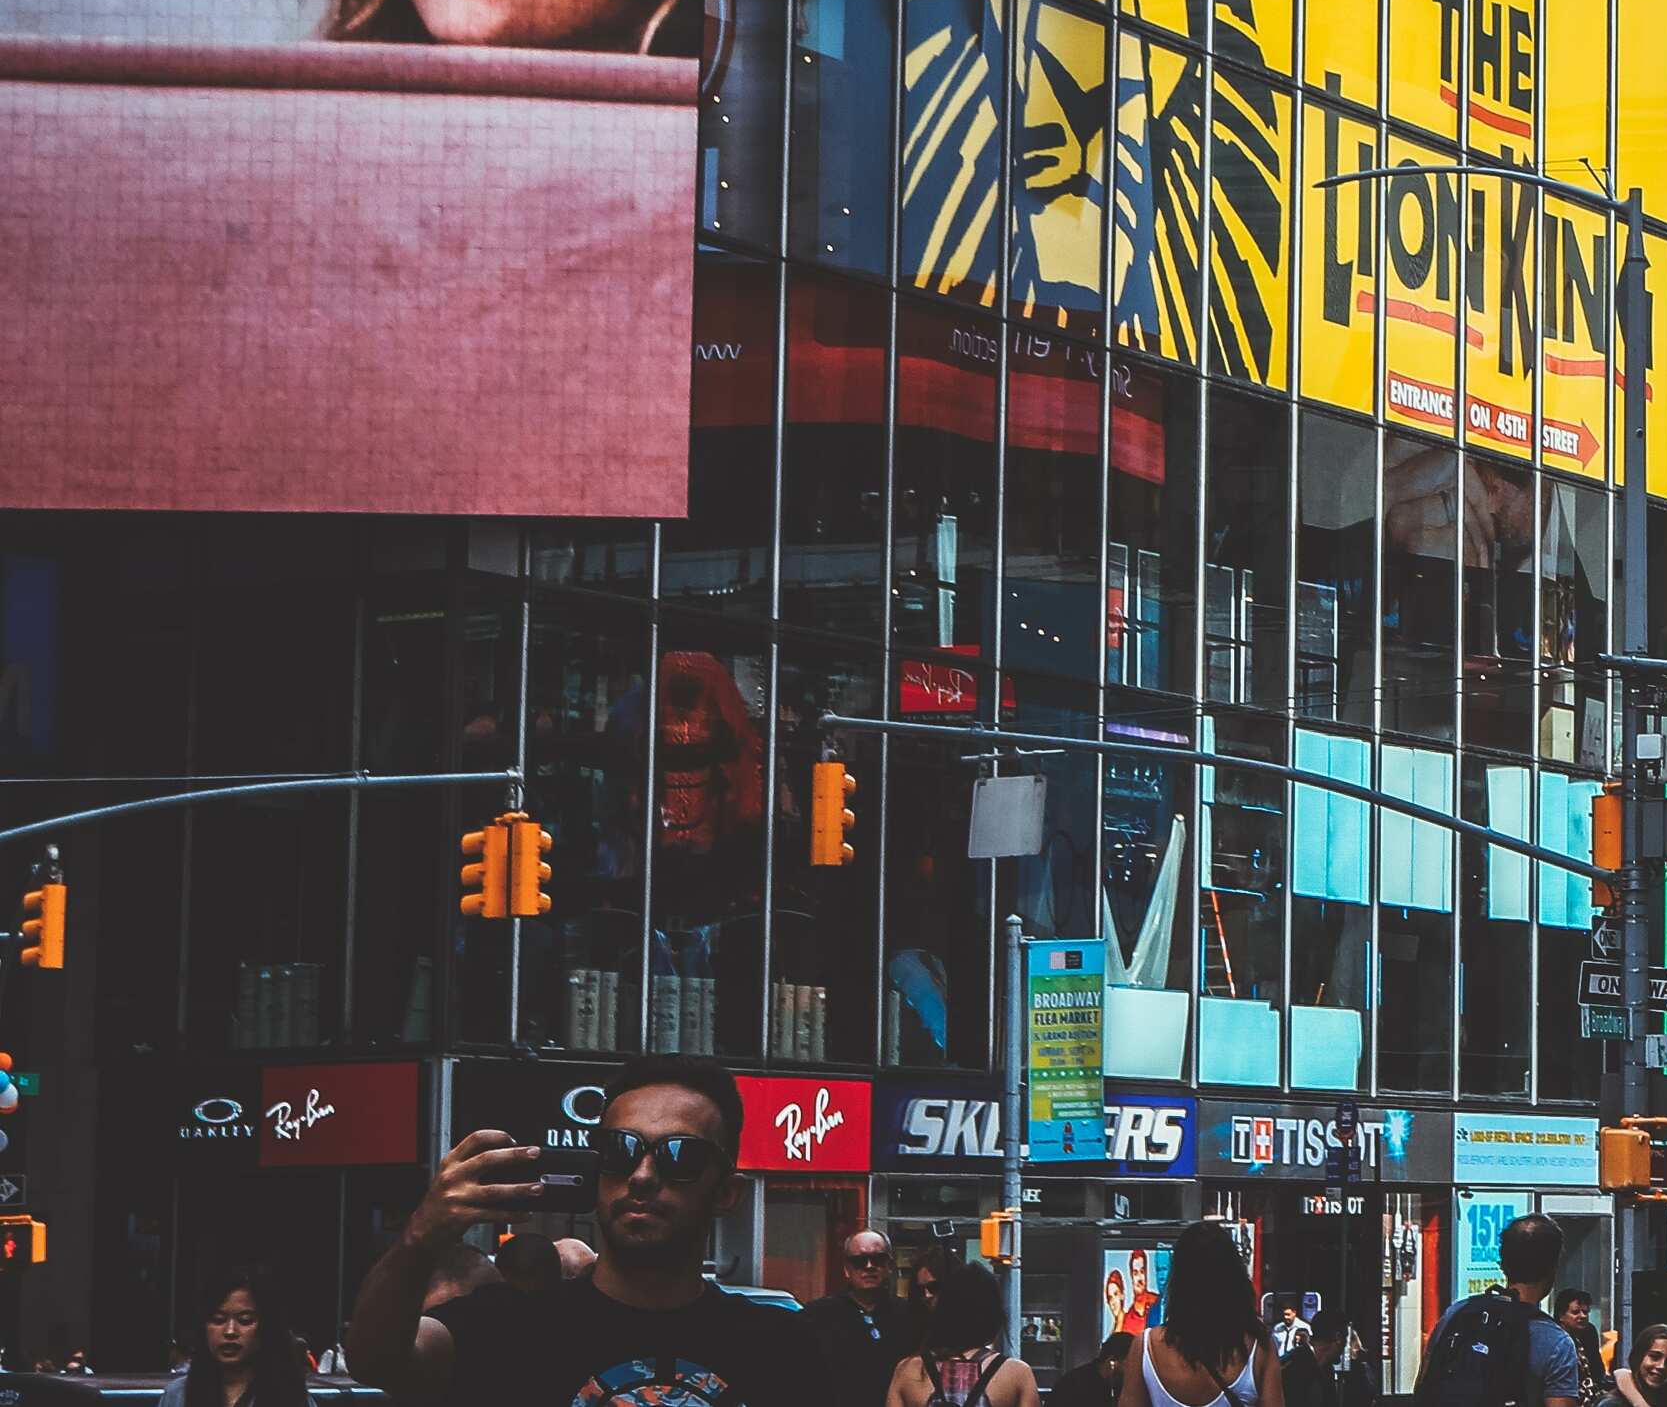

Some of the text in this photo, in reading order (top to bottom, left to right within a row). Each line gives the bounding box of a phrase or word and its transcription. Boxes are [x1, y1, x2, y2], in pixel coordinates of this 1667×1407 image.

[1323, 70, 1485, 329] LION
[1389, 378, 1580, 456] ENTRANCE ON 45TH STREET
[1034, 992, 1101, 1009] BROADWAY
[1597, 975, 1621, 994] ON
[1034, 1009, 1100, 1025] FLEA MARKET
[264, 1088, 335, 1141] Ray-Ban
[774, 1087, 845, 1163] Ray-Ban
[900, 1097, 1188, 1163] SKERS
